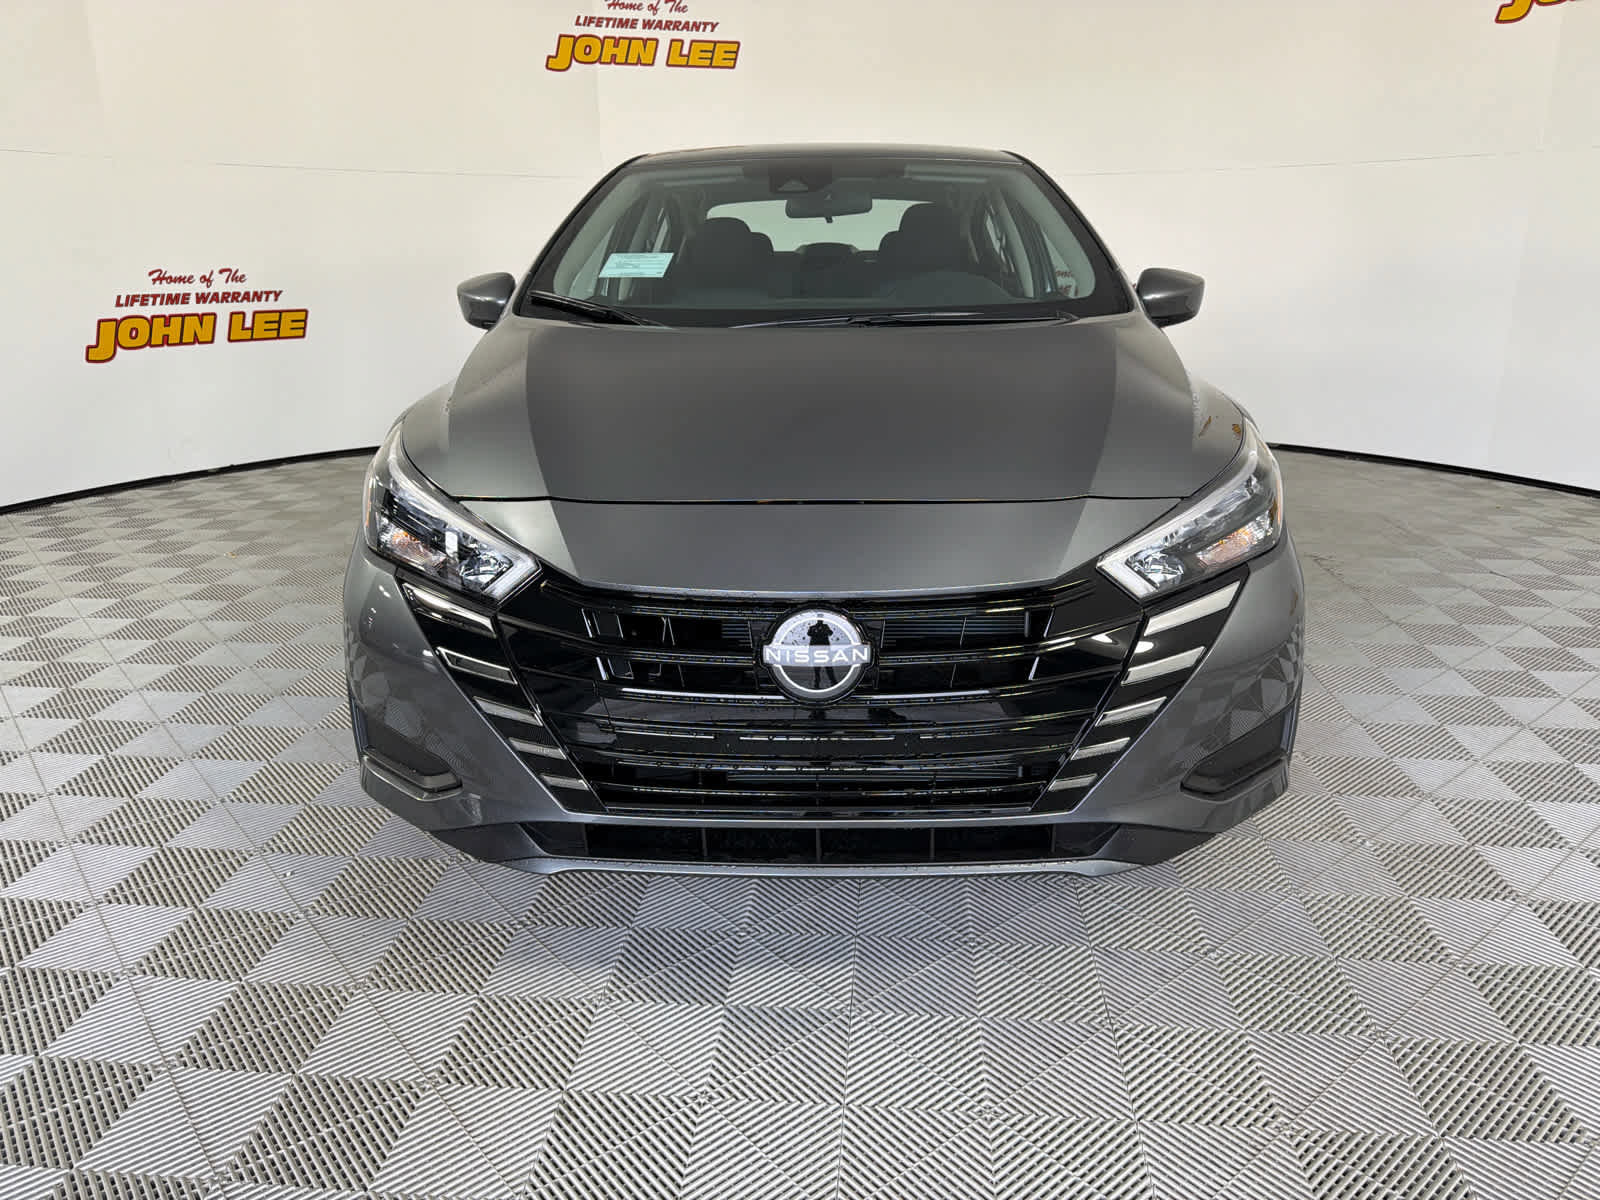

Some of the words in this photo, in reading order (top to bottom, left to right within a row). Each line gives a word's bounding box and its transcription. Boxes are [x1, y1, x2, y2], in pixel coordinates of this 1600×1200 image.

[604, 0, 643, 11] Home
[647, 0, 660, 15] of
[664, 0, 688, 13] The
[574, 15, 639, 30] LIFETIME
[642, 19, 719, 33] WARRANTY
[545, 34, 659, 72] JOHN
[666, 38, 740, 69] LEE
[148, 269, 194, 285] Home
[199, 270, 213, 288] of
[218, 268, 247, 284] The
[115, 293, 191, 307] LIFETIME
[195, 290, 283, 305] WARRANTY
[85, 312, 217, 363] JOHN
[227, 309, 309, 342] LEE
[765, 647, 868, 663] NISSAN
